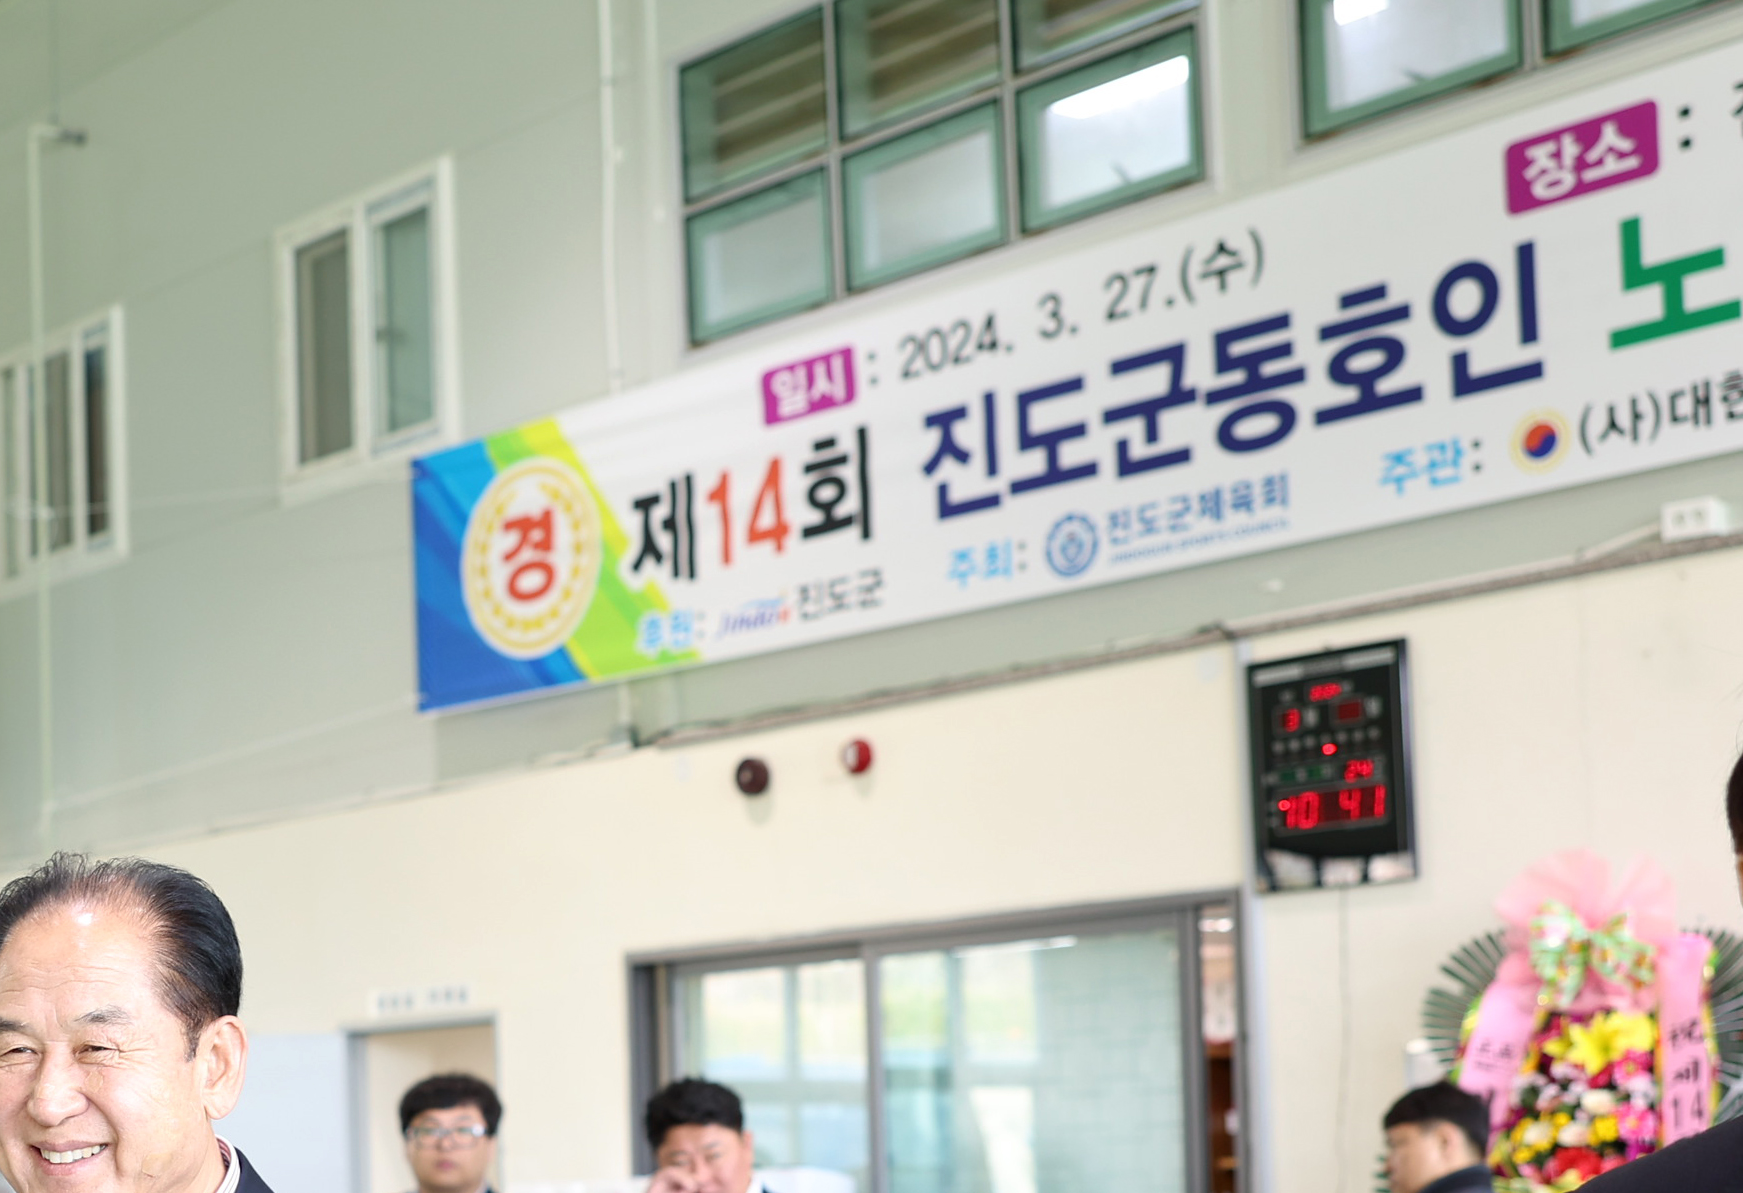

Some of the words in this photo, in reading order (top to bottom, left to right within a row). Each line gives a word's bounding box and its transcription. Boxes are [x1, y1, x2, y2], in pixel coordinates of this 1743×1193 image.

[1522, 117, 1644, 201] 장소
[769, 352, 847, 414] 일시
[900, 312, 1014, 380] 2024.
[922, 241, 1545, 520] 진도군동호인
[501, 506, 557, 603] 경
[1107, 474, 1290, 545] 진도군체육회
[799, 568, 884, 620] 진도군
